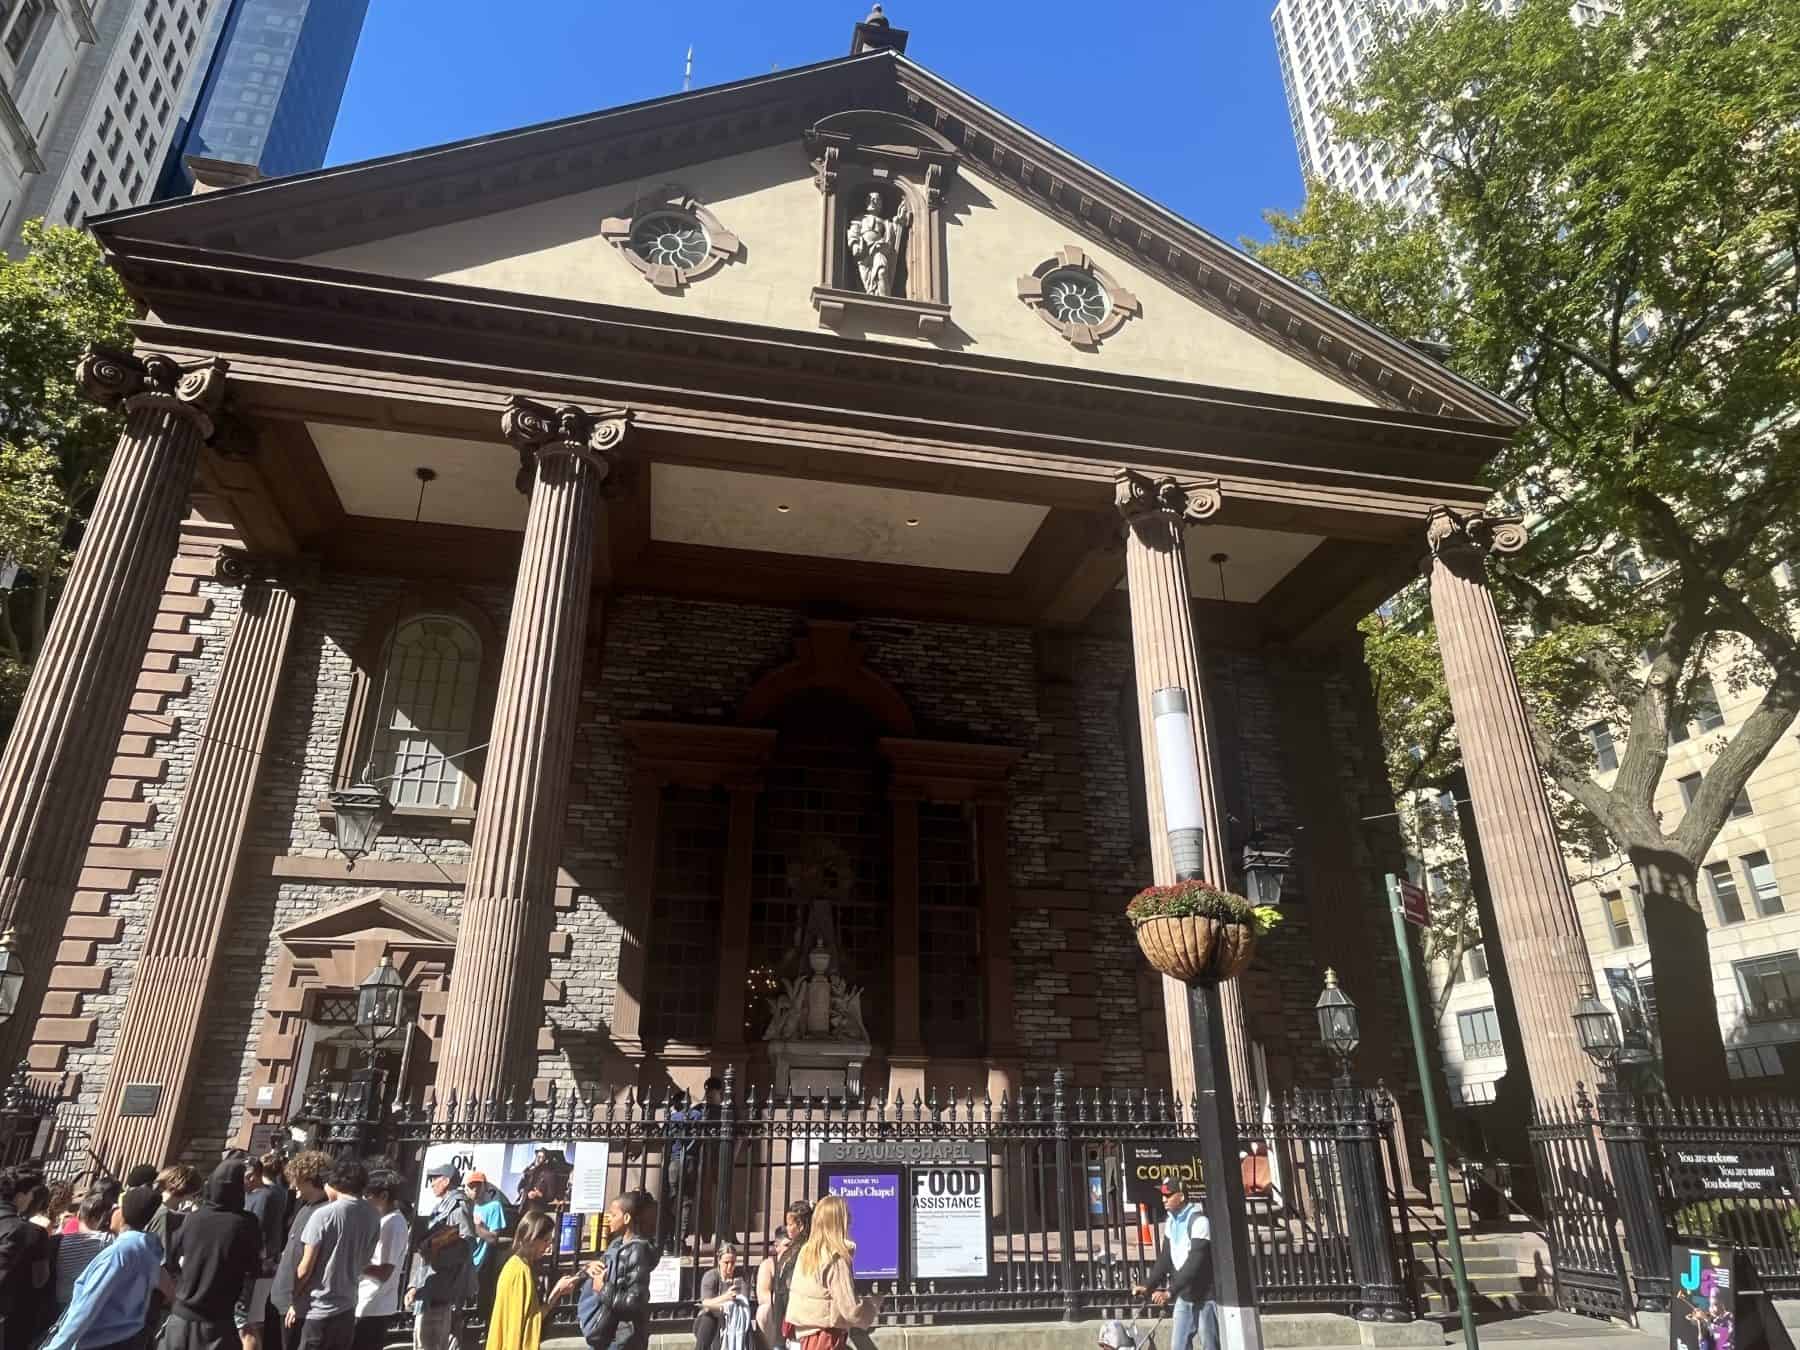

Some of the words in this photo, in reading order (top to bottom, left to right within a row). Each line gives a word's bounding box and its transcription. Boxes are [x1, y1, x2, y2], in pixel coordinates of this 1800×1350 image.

[855, 1143, 905, 1160] PAUL'S
[910, 1143, 971, 1160] CHAPEL
[1677, 1152, 1694, 1163] You
[1694, 1155, 1707, 1163] are
[1707, 1152, 1739, 1163] welcome
[1718, 1165, 1735, 1177] You
[1735, 1168, 1748, 1177] are
[1748, 1165, 1775, 1177] wanted
[911, 1169, 981, 1196] FOOD
[1701, 1177, 1718, 1189] You
[1743, 1177, 1761, 1189] here
[840, 1186, 864, 1197] Paul's
[864, 1186, 895, 1199] Chapel
[912, 1197, 982, 1209] ASSISTANCE
